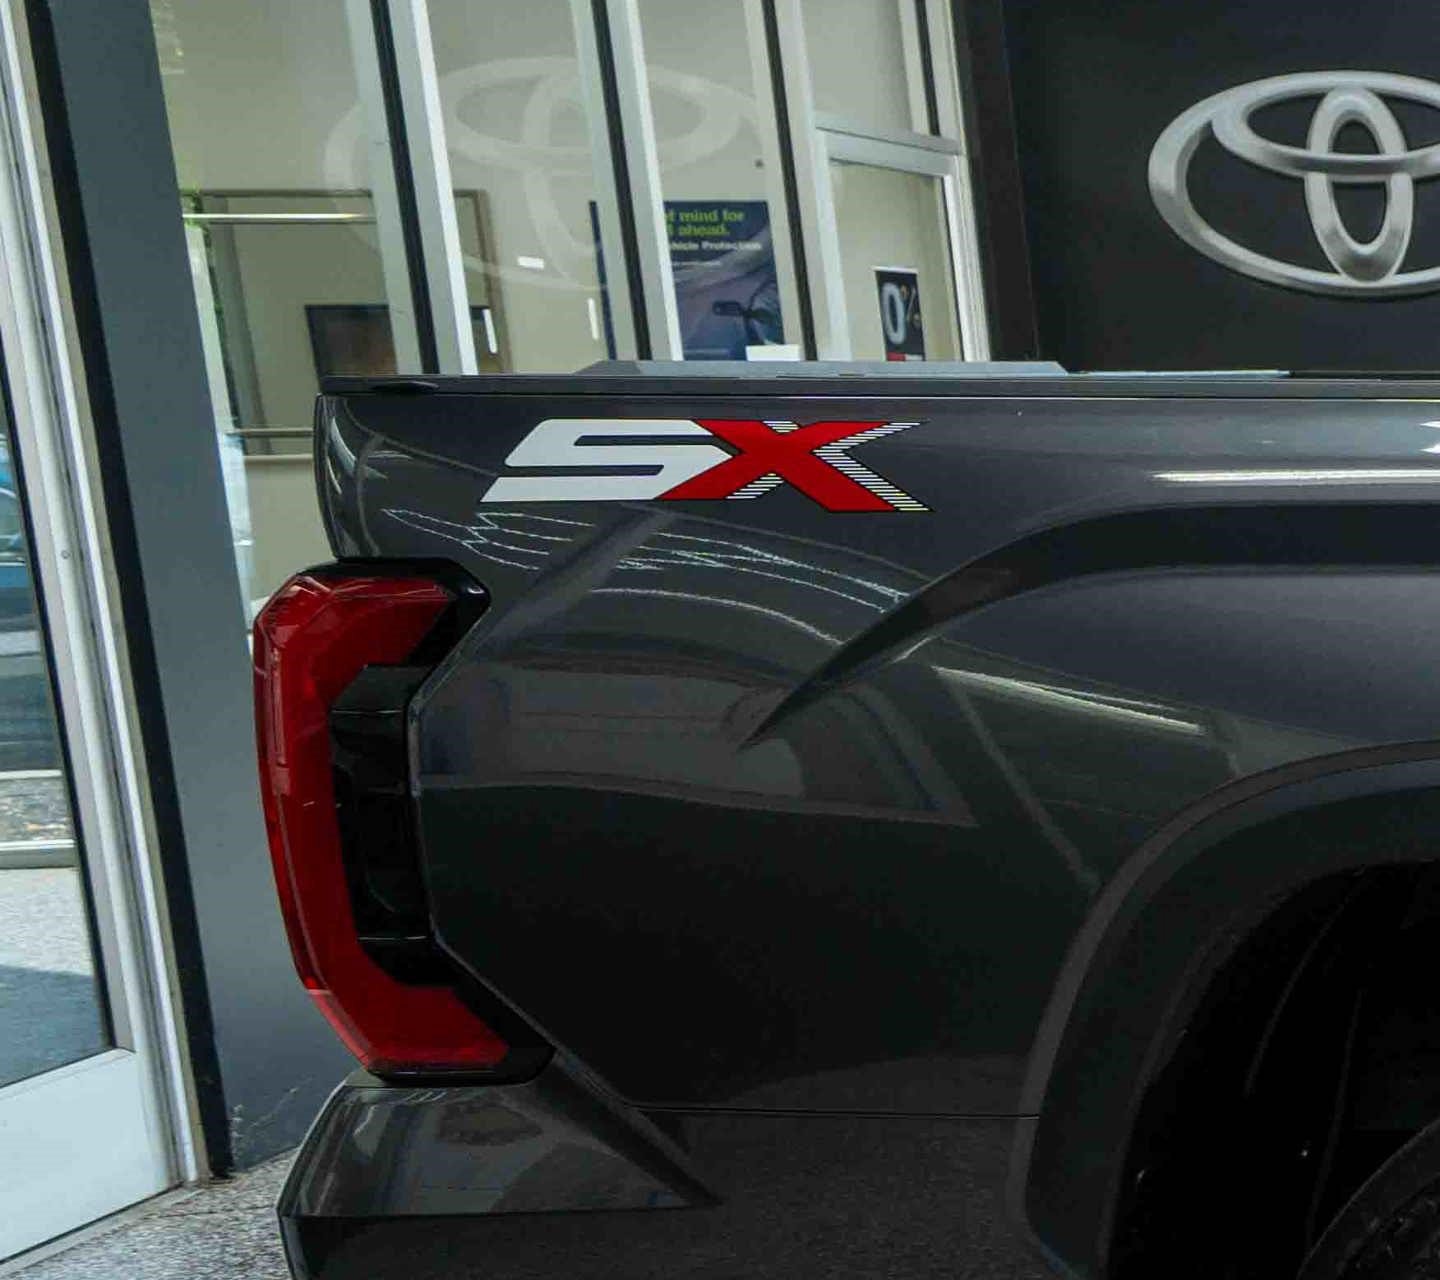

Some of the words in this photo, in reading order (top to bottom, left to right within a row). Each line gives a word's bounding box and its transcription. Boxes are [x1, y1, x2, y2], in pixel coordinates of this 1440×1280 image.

[679, 208, 718, 221] mind
[722, 208, 745, 221] for
[881, 282, 921, 345] 0%
[479, 417, 936, 513] SX
